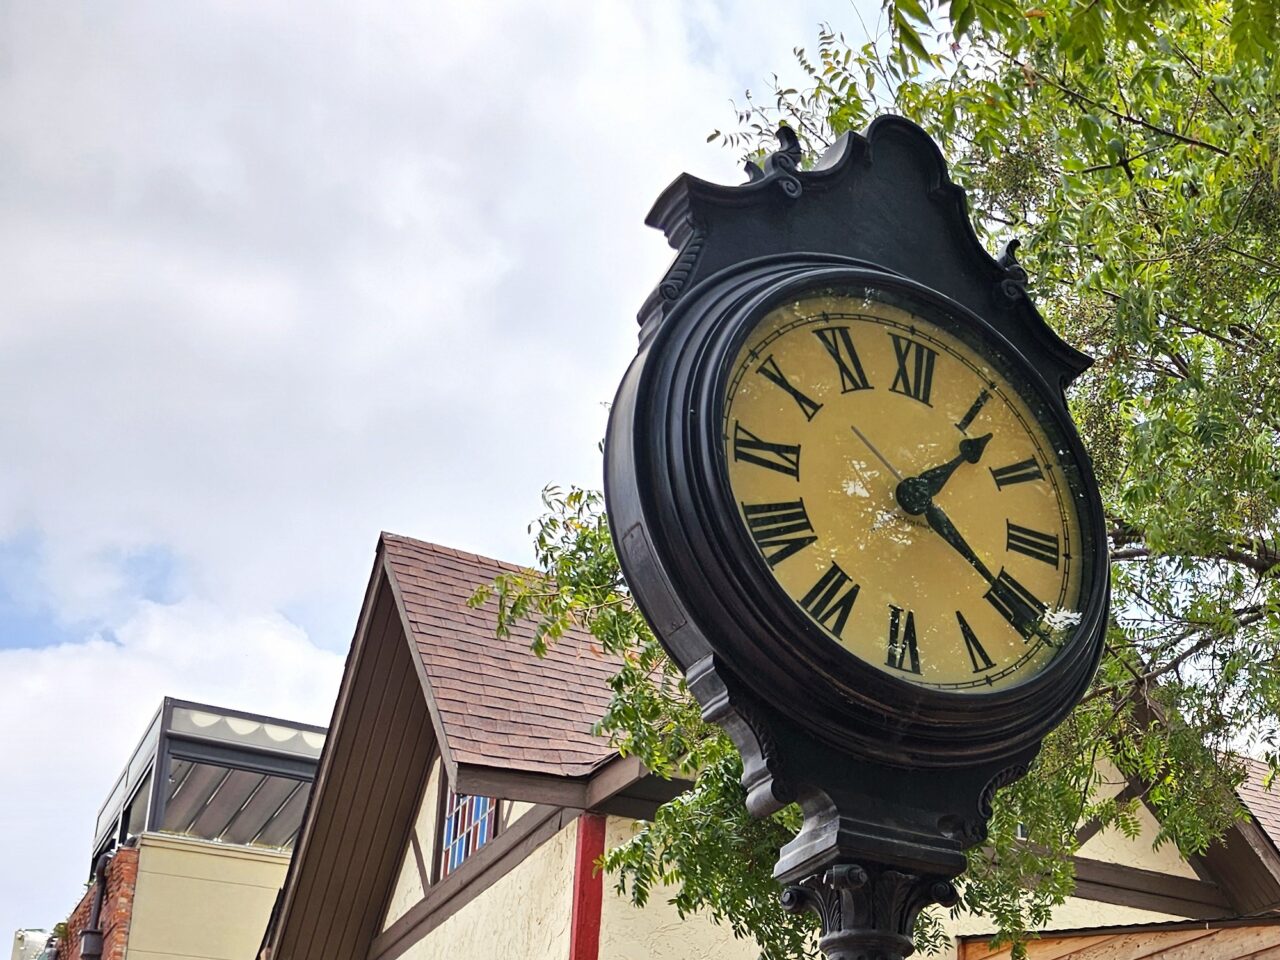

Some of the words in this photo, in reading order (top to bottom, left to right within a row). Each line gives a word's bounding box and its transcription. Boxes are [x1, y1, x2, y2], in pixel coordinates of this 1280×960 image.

[756, 354, 824, 422] X
[812, 327, 875, 394] XI
[888, 332, 940, 408] XII
[954, 387, 993, 436] I
[734, 420, 801, 482] IX
[989, 454, 1045, 491] II
[741, 497, 818, 571] VIII
[1006, 518, 1059, 570] III
[796, 560, 861, 641] VII
[982, 566, 1050, 644] II
[884, 604, 923, 675] VI
[956, 610, 997, 674] V
